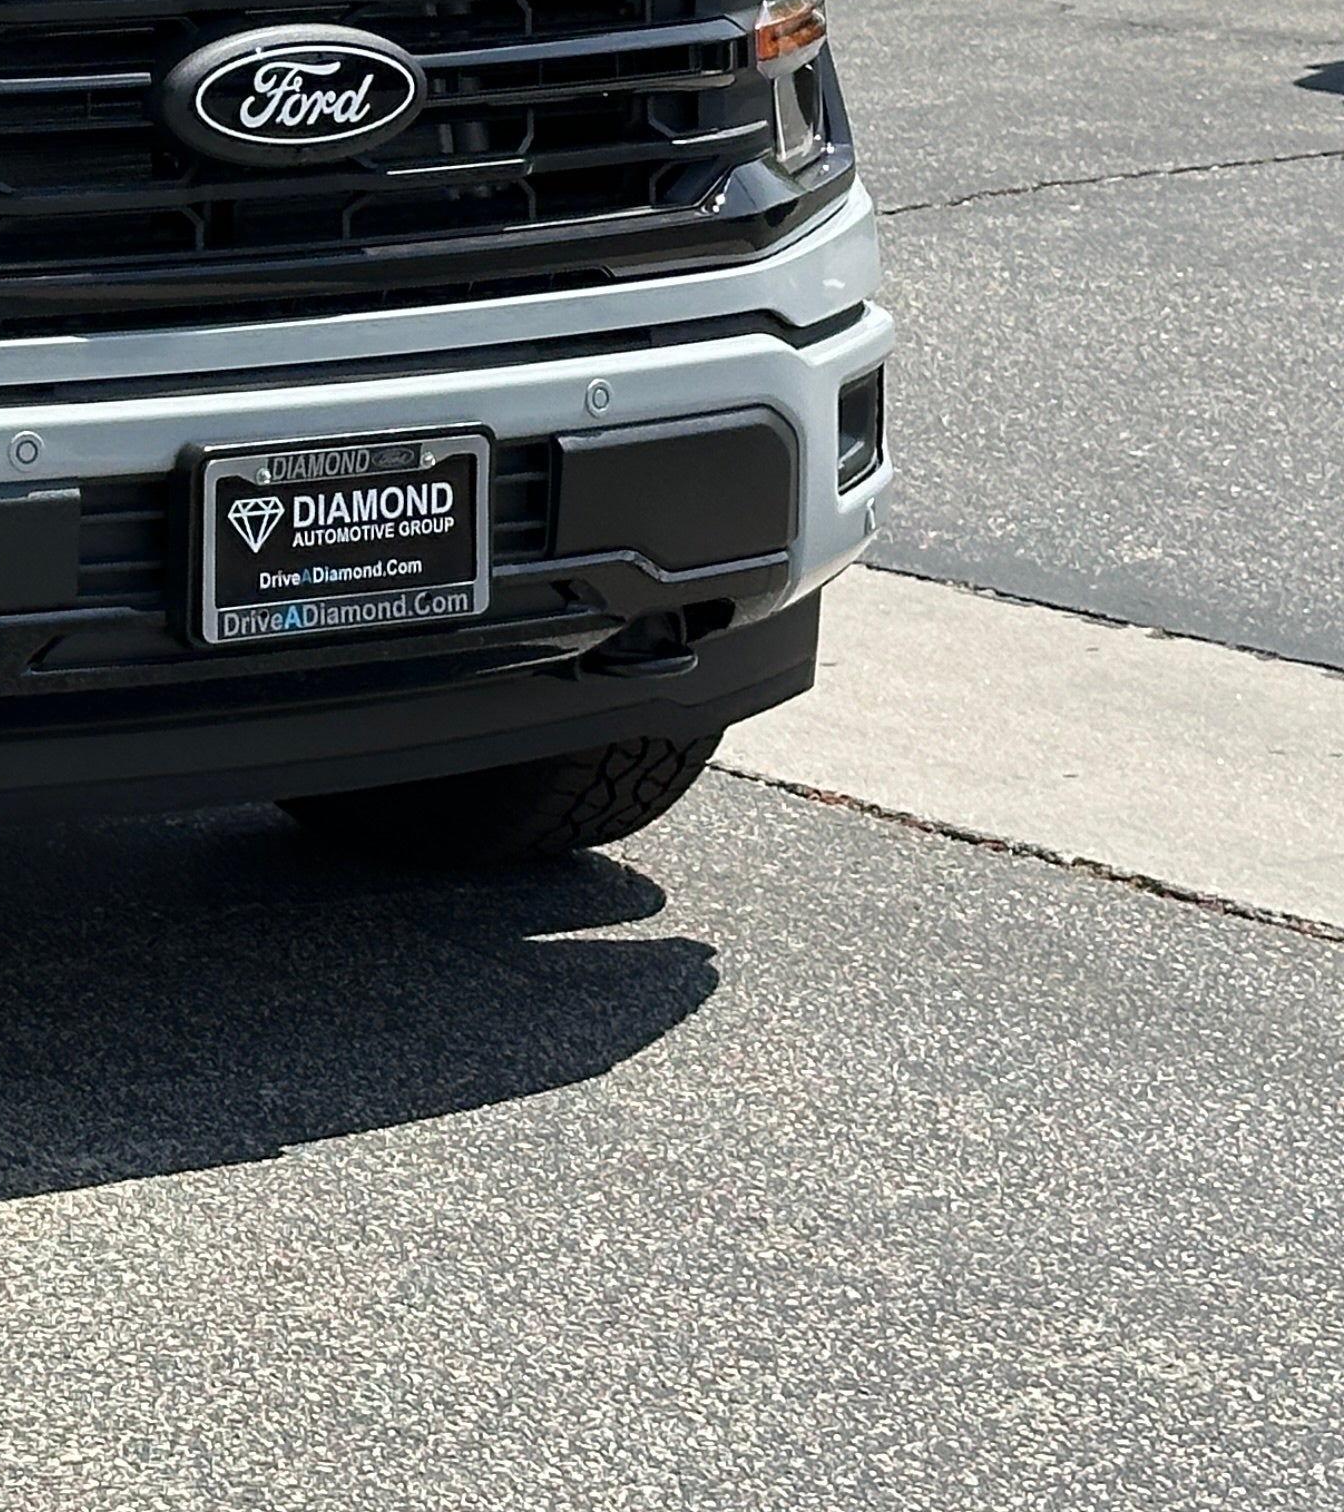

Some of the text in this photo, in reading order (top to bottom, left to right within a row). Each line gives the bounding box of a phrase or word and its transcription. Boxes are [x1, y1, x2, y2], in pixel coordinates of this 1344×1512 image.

[240, 61, 374, 128] Ford
[272, 449, 370, 481] DIAMOND
[293, 481, 454, 528] DIAMOND
[292, 517, 455, 548] AUTOMOTIVE GROUP
[260, 559, 422, 589] DriveADiamond.Com
[224, 591, 469, 637] DriveADiamond.Com
